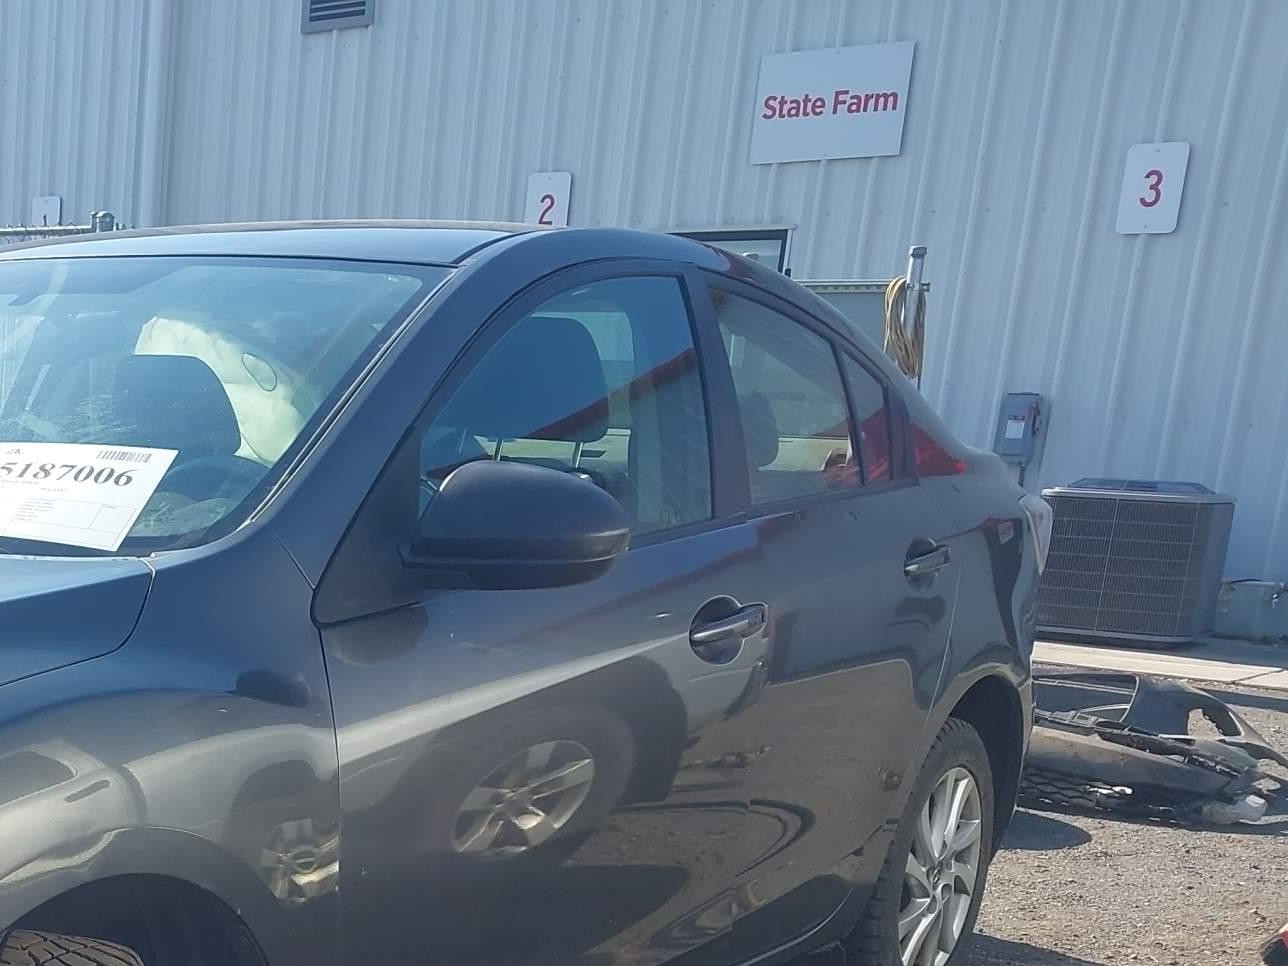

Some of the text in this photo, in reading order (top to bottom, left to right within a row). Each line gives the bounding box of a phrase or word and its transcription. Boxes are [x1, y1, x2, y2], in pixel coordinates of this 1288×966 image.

[762, 89, 898, 120] State Farm
[1139, 169, 1163, 208] 3
[538, 193, 555, 226] 2
